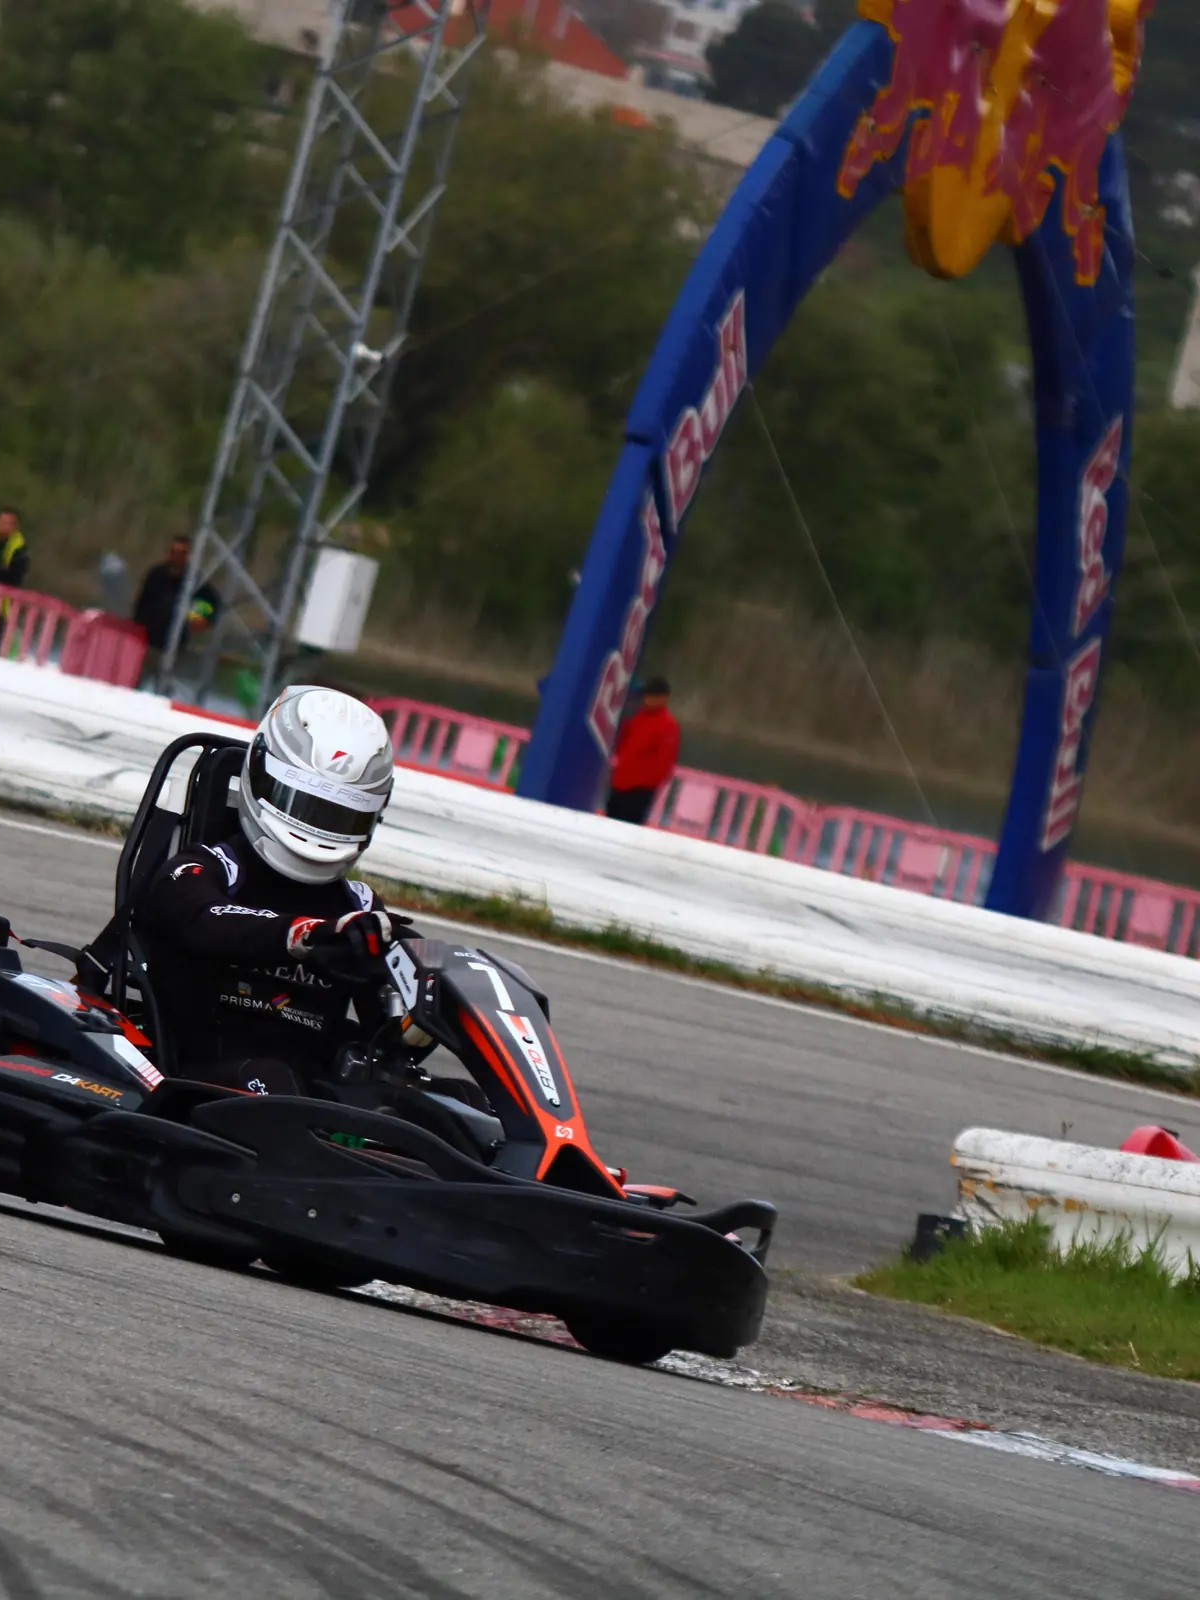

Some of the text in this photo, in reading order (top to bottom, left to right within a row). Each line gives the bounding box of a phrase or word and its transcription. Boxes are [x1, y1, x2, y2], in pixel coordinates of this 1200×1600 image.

[665, 287, 748, 532] Bull
[284, 768, 371, 806] BLUE FISH
[220, 993, 273, 1011] PRISMA
[467, 961, 515, 1012] 7
[280, 1010, 323, 1031] MOLDES
[51, 1073, 123, 1100] DAKART
